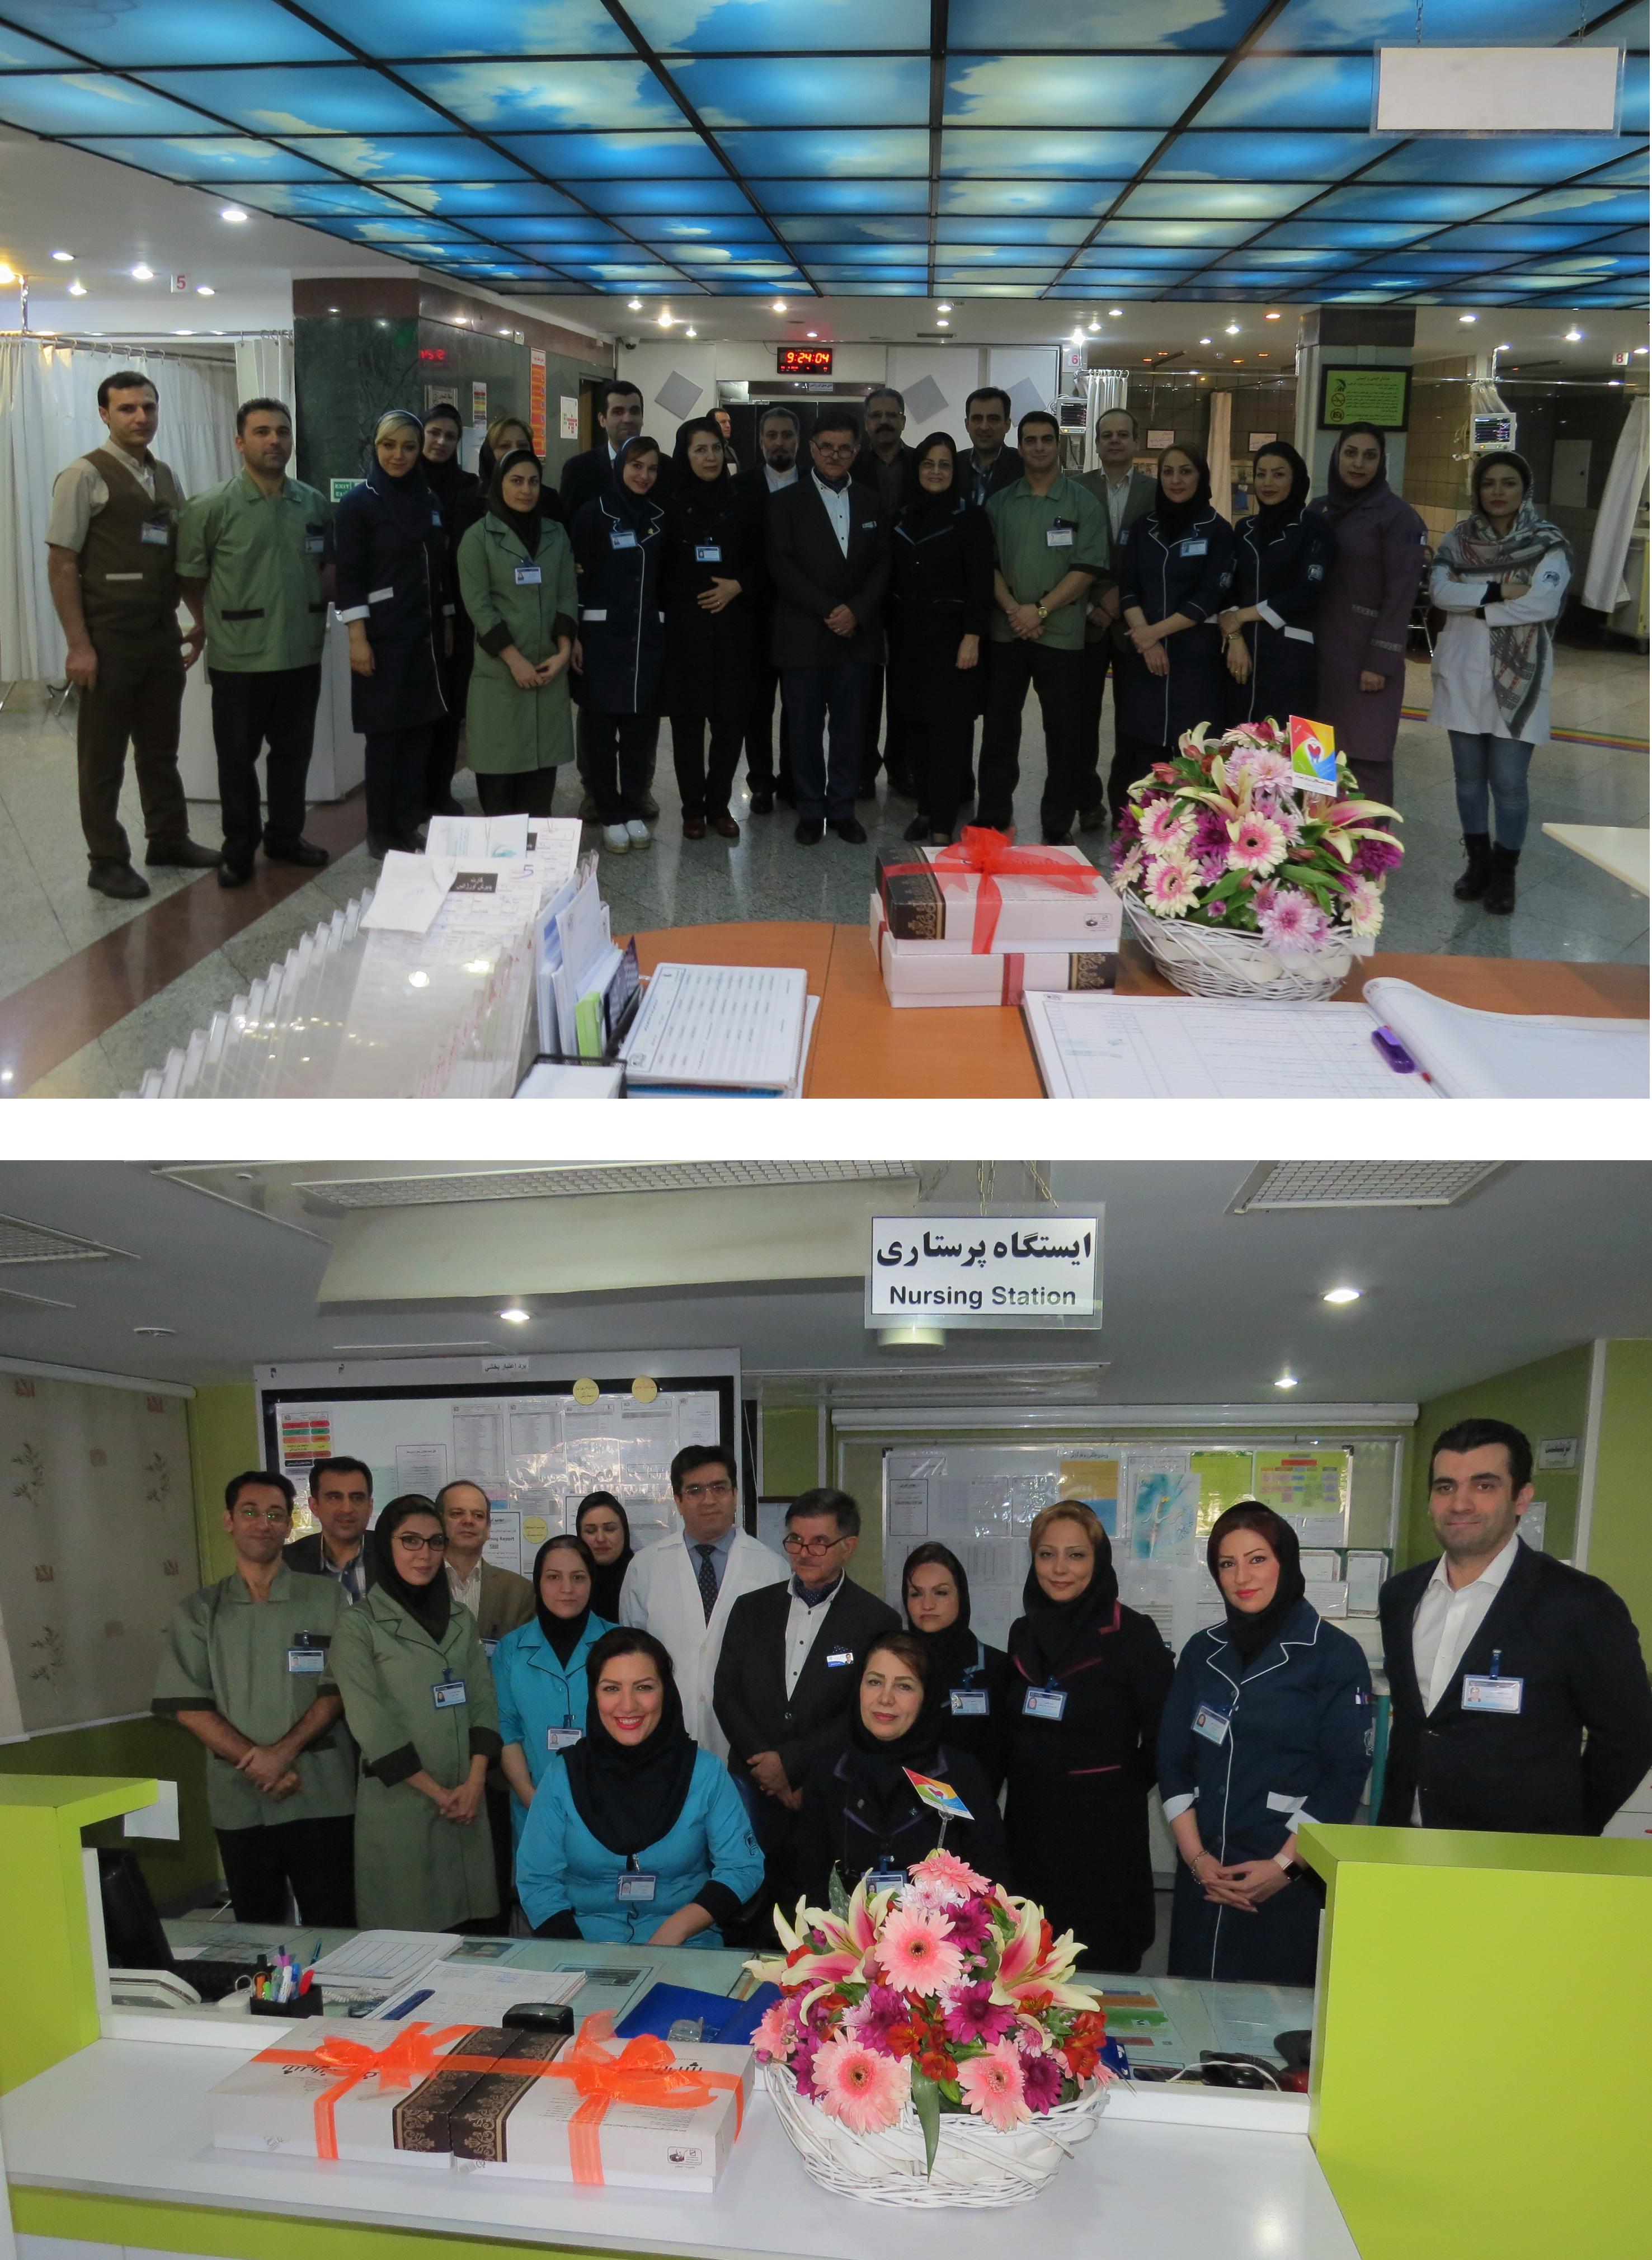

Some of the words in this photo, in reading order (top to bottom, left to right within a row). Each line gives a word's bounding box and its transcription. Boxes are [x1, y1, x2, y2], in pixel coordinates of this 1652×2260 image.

[177, 276, 186, 289] 5
[787, 352, 830, 364] 9:24:04
[1072, 355, 1078, 364] 6
[1616, 354, 1623, 363] 8
[877, 1231, 986, 1268] پرستاری
[994, 1231, 1091, 1266] ایستگاه
[890, 1286, 983, 1309] Nursing
[992, 1286, 1076, 1306] Station
